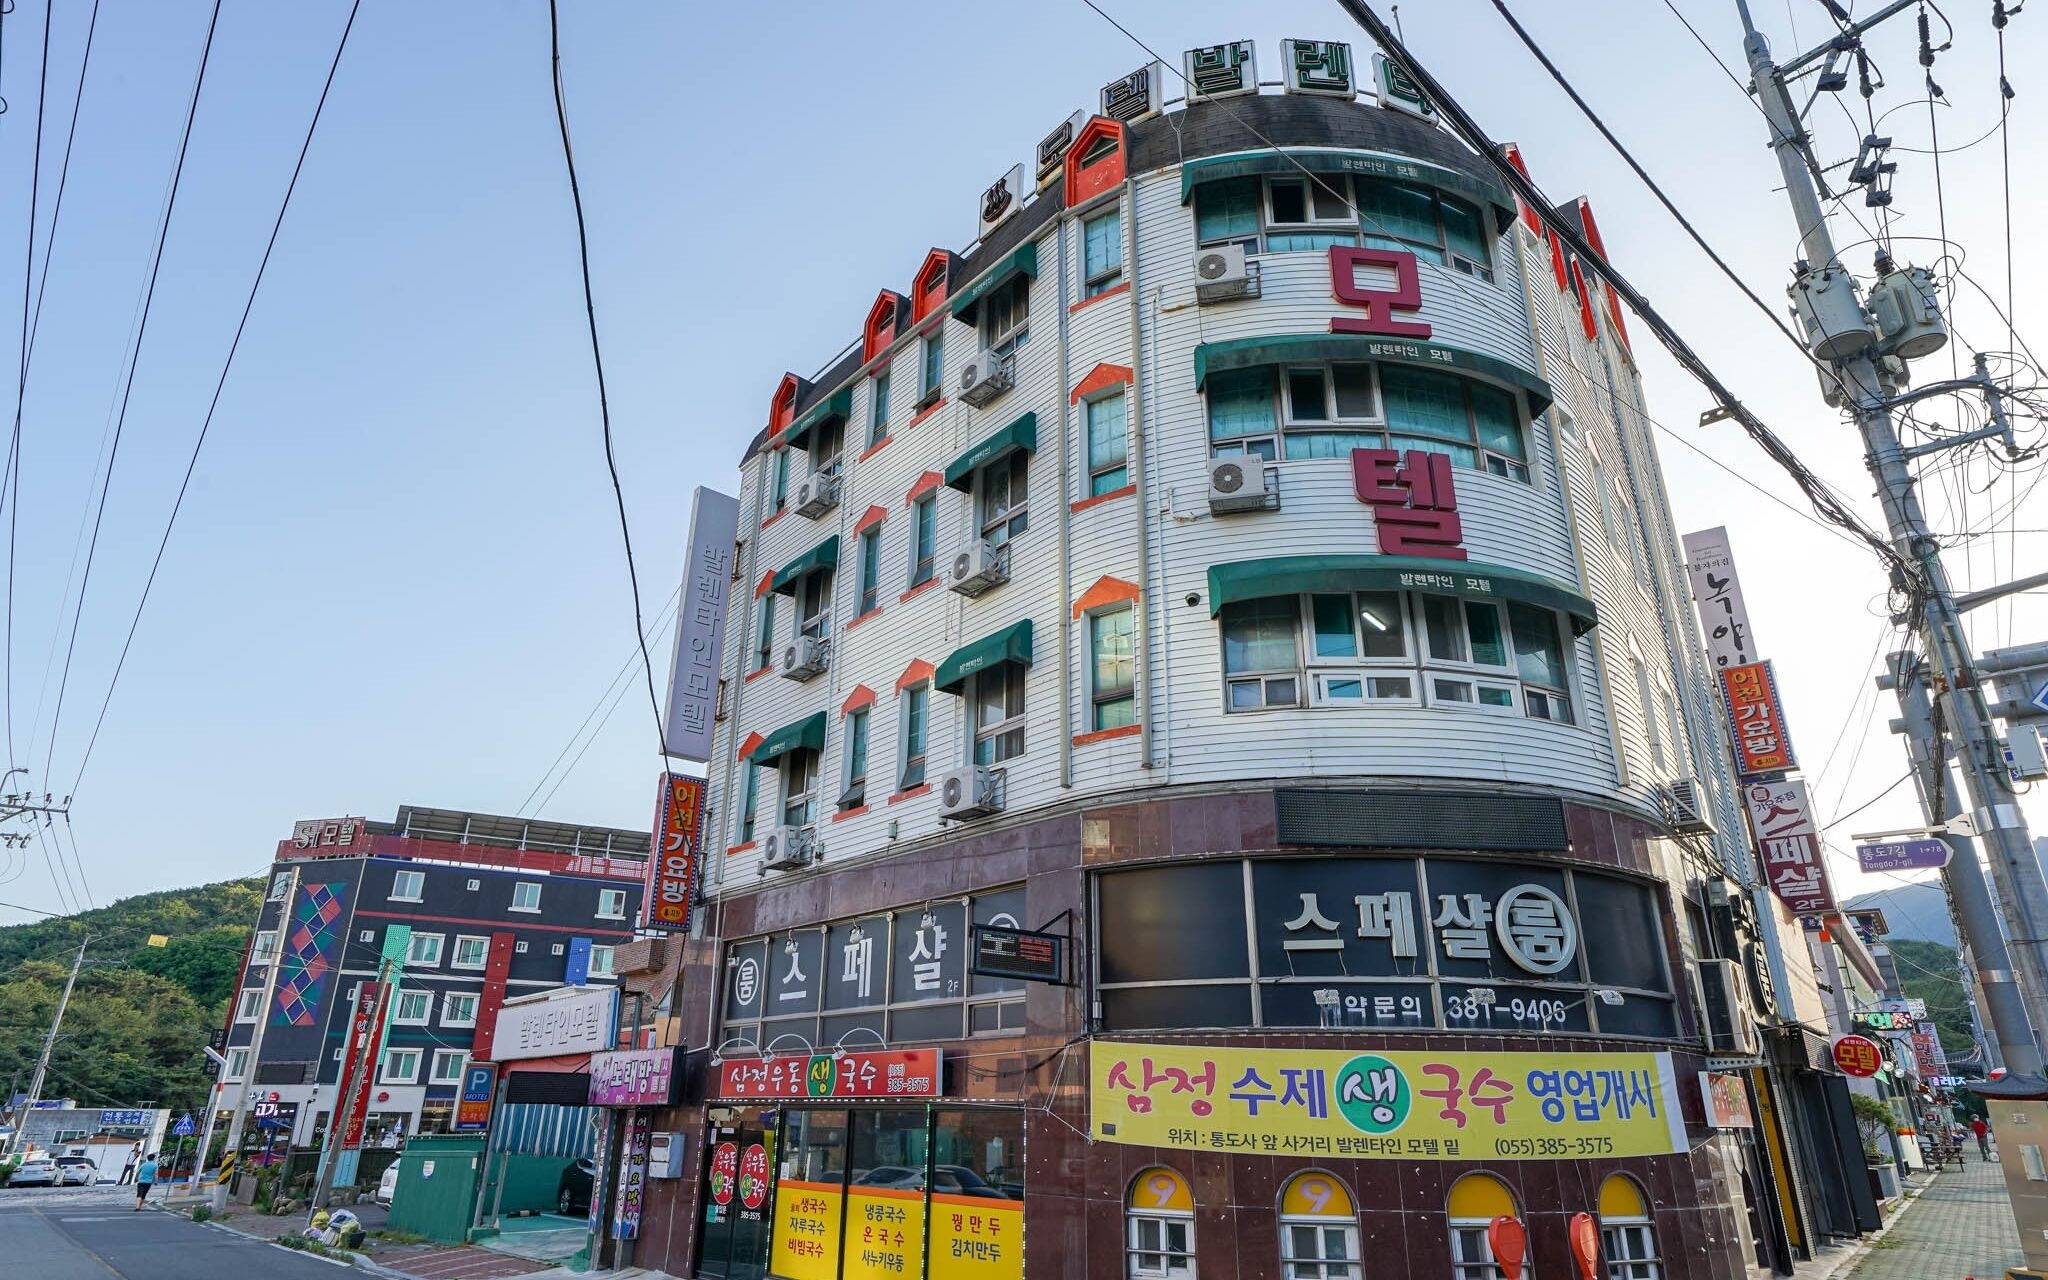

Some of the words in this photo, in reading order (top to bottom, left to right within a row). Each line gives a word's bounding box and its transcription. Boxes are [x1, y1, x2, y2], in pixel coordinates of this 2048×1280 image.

[1370, 344, 1419, 357] 발렌타인
[1430, 349, 1453, 362] 모텔
[1400, 573, 1455, 588] 발렌타인
[1466, 578, 1491, 591] 모텔
[1755, 790, 1797, 812] 가요주점
[322, 821, 354, 846] 모텔
[1862, 845, 1907, 860] 통도7길
[1795, 898, 1825, 910] 2F
[948, 980, 958, 992] 2F
[1318, 995, 1421, 1019] 약문의
[1448, 995, 1566, 1023] 381-9406
[1839, 1045, 1876, 1070] 모텔
[611, 1059, 653, 1094] 노래방
[730, 1061, 800, 1092] 삼정우동
[888, 1063, 905, 1076] (055)
[471, 1071, 488, 1090] P
[888, 1077, 929, 1092] 385-3575
[1108, 1058, 1216, 1117] 삼정
[1229, 1067, 1328, 1119] 수제
[1527, 1069, 1657, 1123] 영업개시
[1210, 1131, 1257, 1150] 통도사
[1262, 1134, 1278, 1151] 앞
[1282, 1135, 1331, 1153] 사거리
[1337, 1137, 1401, 1155] 발렌타인
[1407, 1139, 1439, 1155] 모텔
[1444, 1139, 1460, 1155] 밑
[801, 1198, 827, 1214] 생국수
[865, 1203, 906, 1225] 냉콩국수
[789, 1217, 825, 1236] 자루국수
[788, 1238, 824, 1258] 비빔국수
[952, 1238, 1001, 1262] 김치만두
[862, 1250, 904, 1273] 사누키우동
